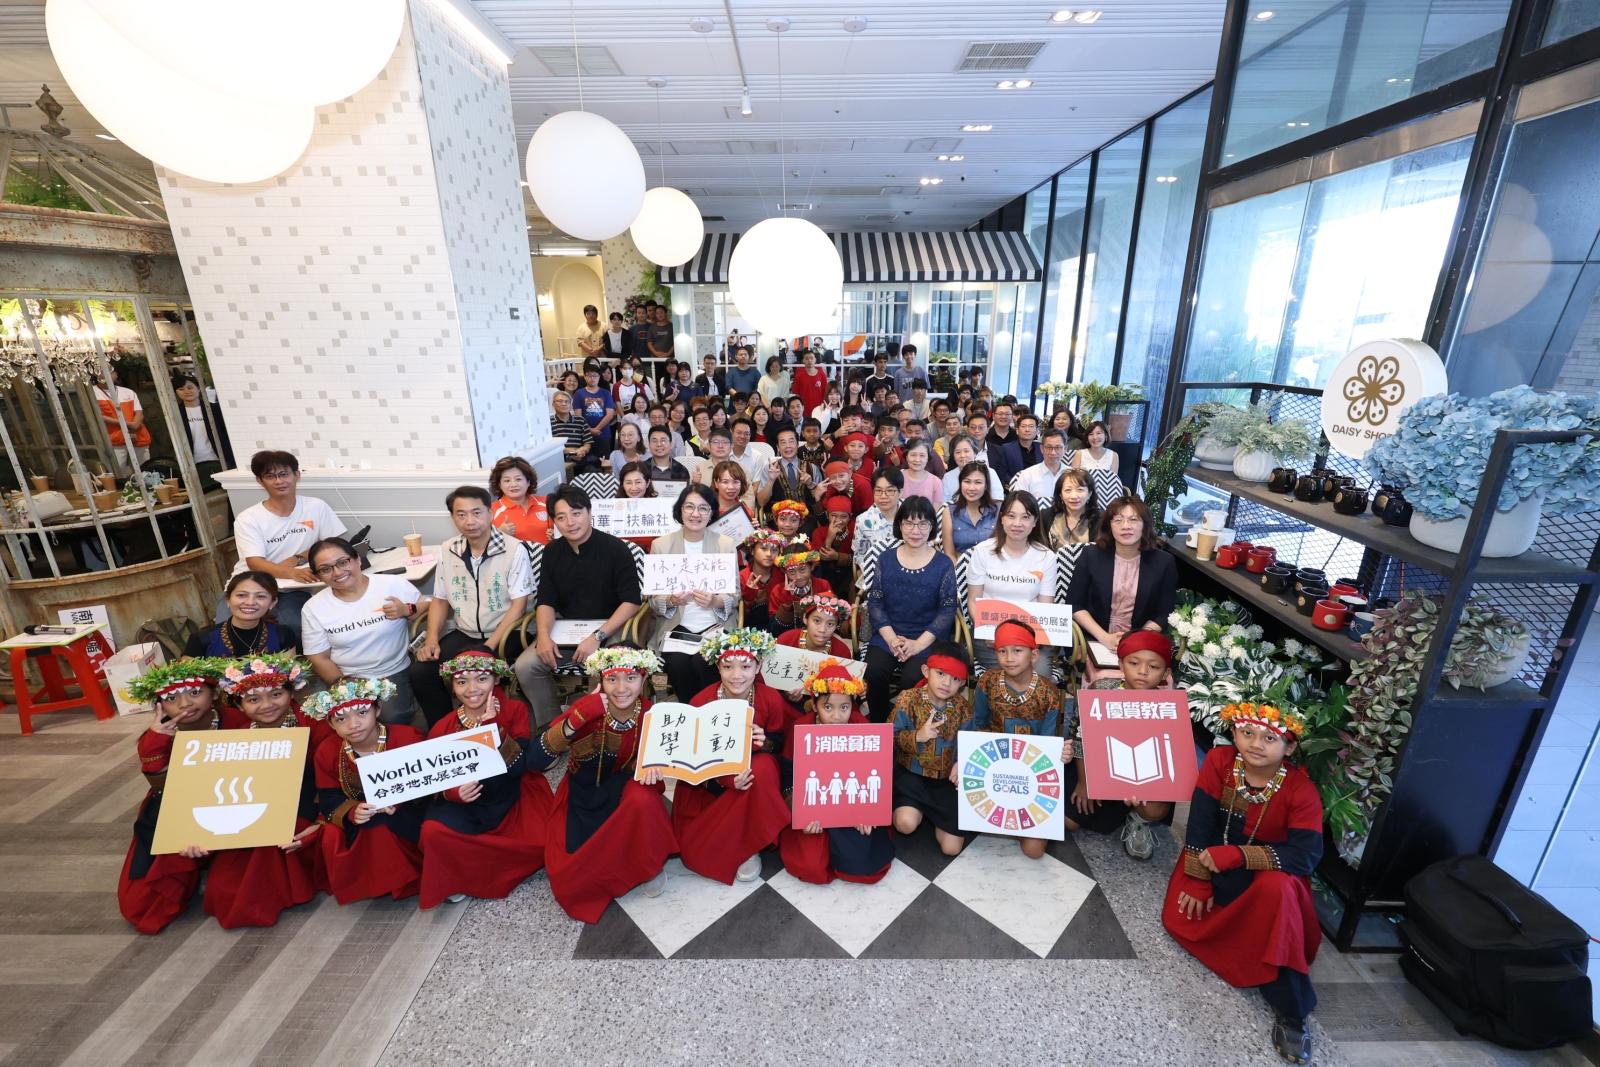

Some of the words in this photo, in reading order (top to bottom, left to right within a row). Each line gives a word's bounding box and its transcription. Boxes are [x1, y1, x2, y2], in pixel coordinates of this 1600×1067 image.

[1332, 425, 1362, 437] DAISY
[652, 576, 727, 593] 上學的原因
[986, 572, 1009, 582] World
[1010, 575, 1036, 584] Vision
[324, 622, 355, 634] World
[356, 614, 388, 628] Vision
[980, 611, 1069, 627] 豐盛兒童生命的展望
[765, 659, 815, 683] 兒童資
[1089, 698, 1103, 721] 4
[1105, 701, 1178, 720] 優質教育
[183, 740, 200, 766] 2
[203, 740, 292, 763] 消除飢餓
[804, 733, 812, 755] 1
[815, 735, 881, 753] 消除貧窮
[367, 759, 423, 785] World
[426, 748, 478, 768] Vision
[374, 762, 480, 799] 台灣世界展望會
[992, 773, 1030, 782] SUSTAINABLE
[992, 779, 1030, 787] DEVELOPMENT
[993, 783, 1030, 795] GOALS
